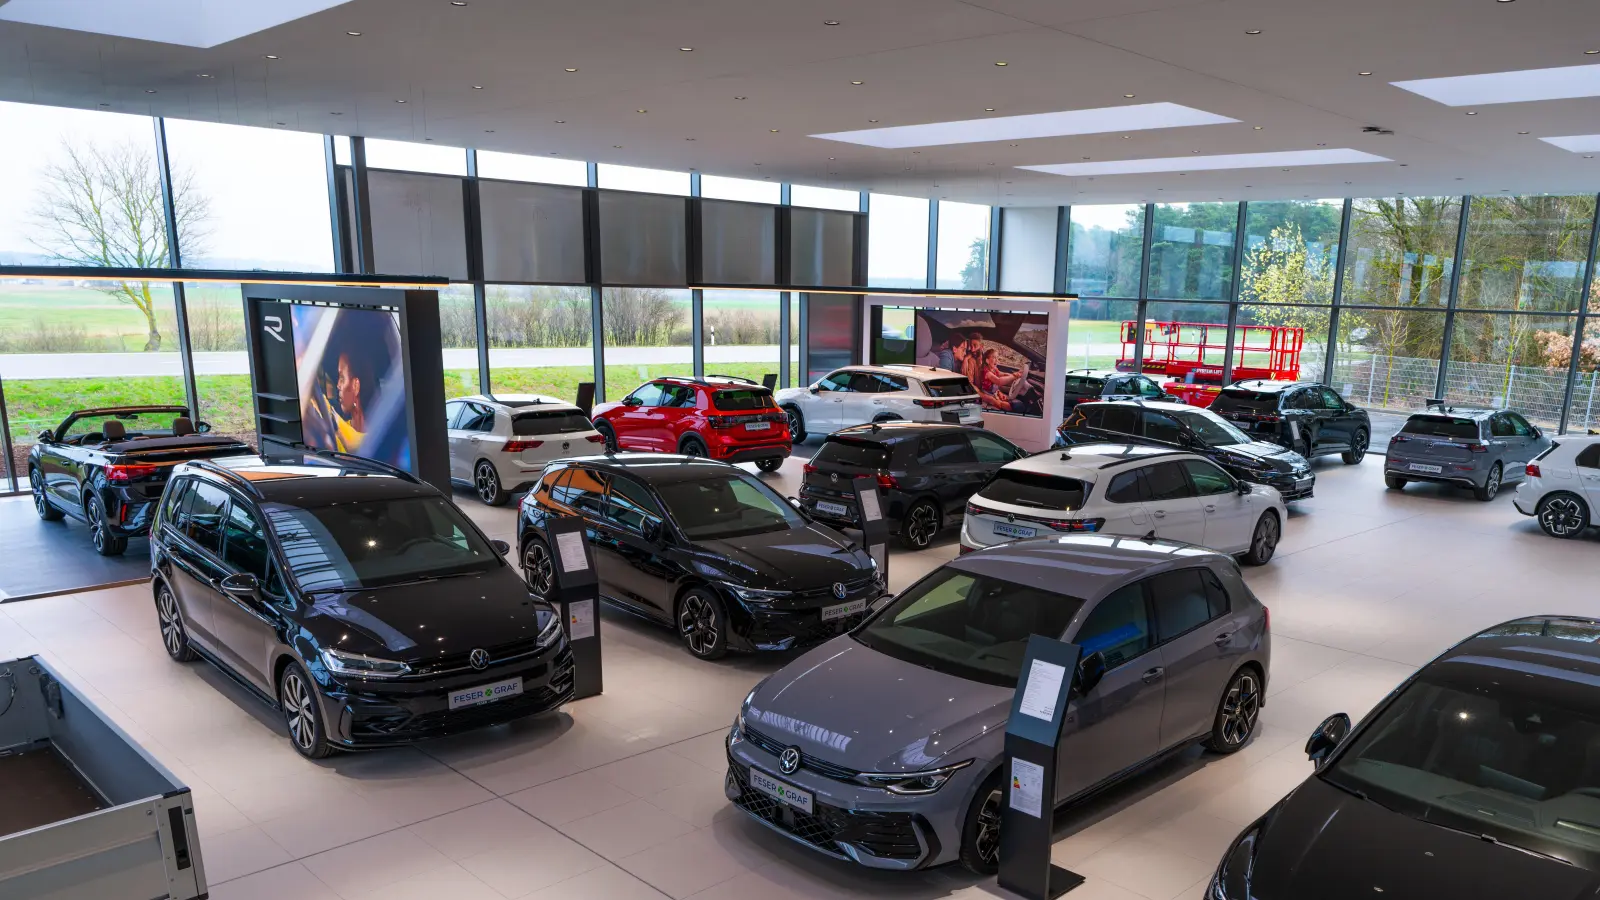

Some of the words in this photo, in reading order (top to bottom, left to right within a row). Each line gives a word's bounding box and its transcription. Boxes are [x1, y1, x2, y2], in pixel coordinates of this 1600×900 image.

[997, 525, 1012, 533] FESER
[824, 607, 843, 617] FESER
[848, 602, 864, 611] GRAF
[454, 691, 484, 703] FESER
[494, 682, 518, 695] GRAF
[753, 774, 777, 792] FESER
[785, 790, 808, 805] GRAF
